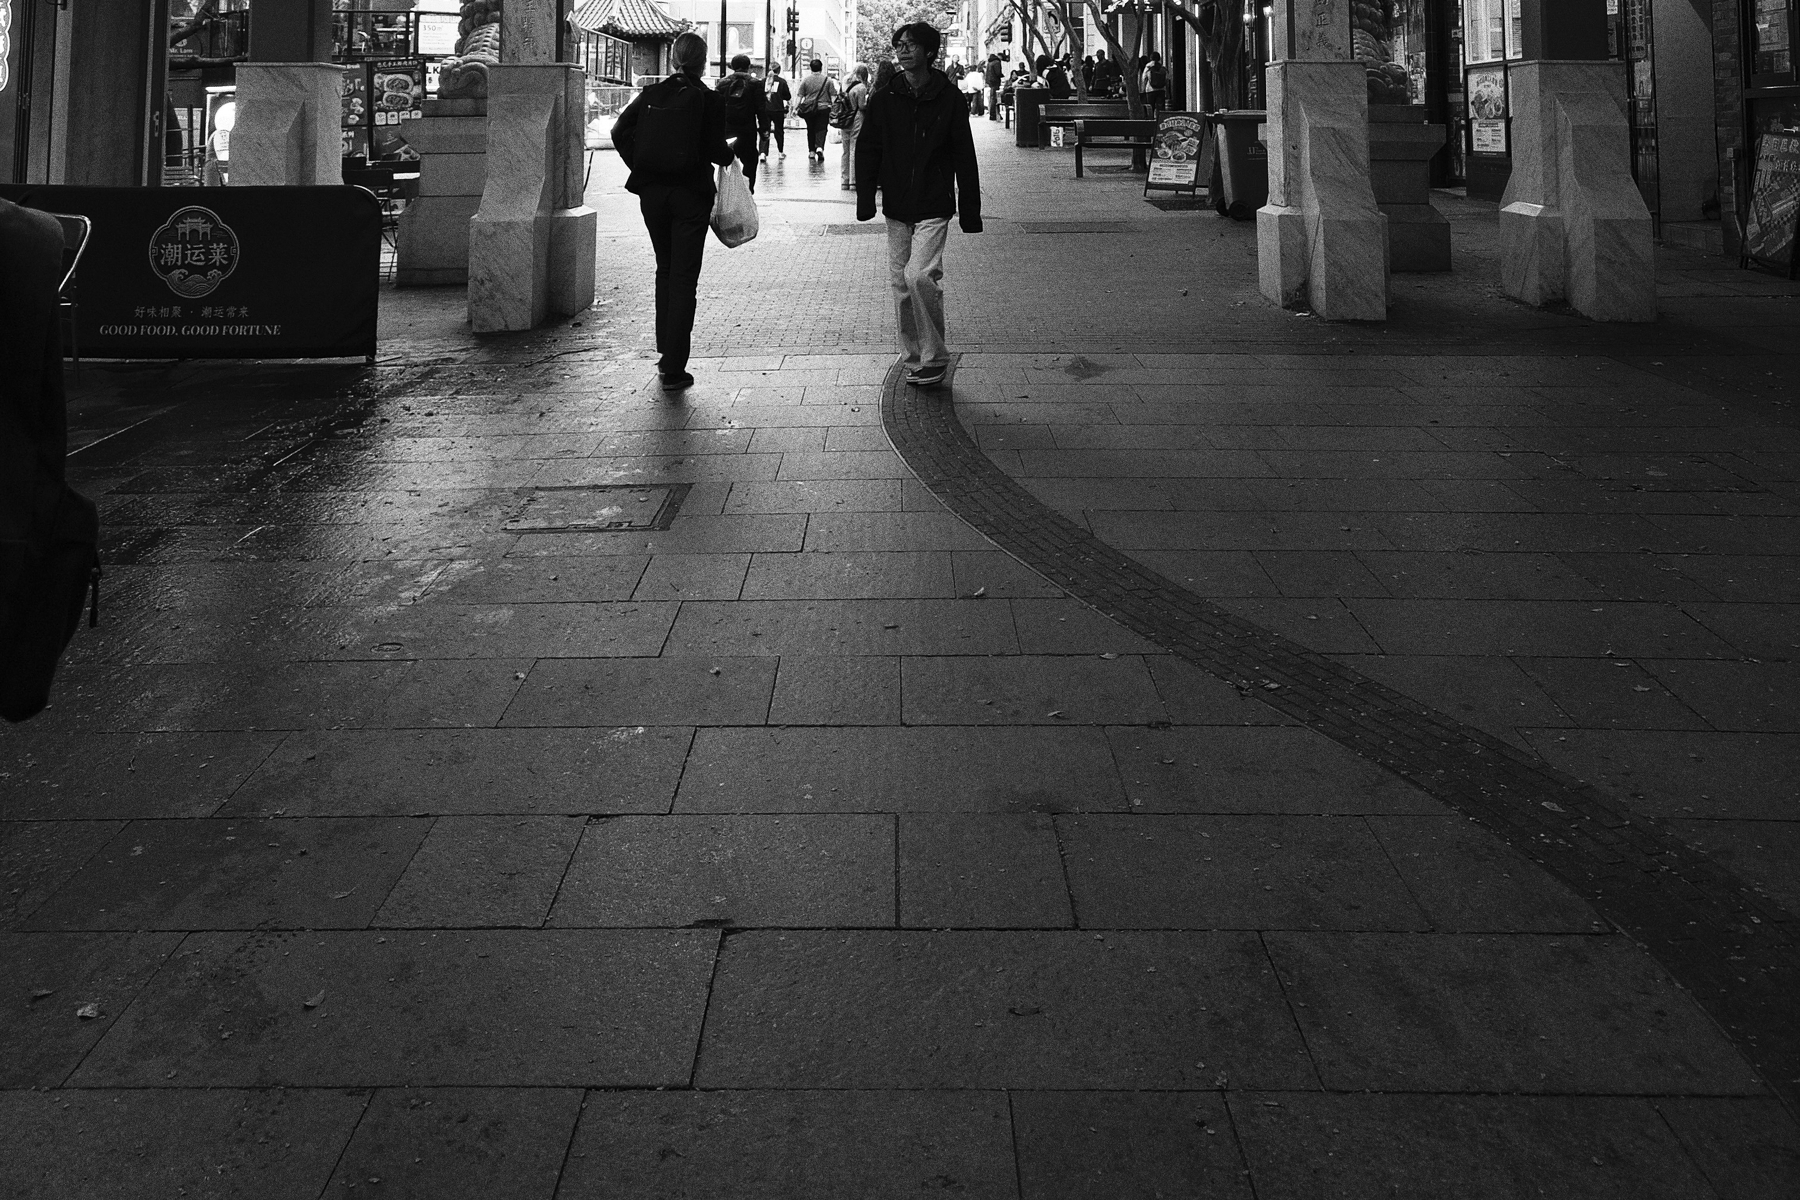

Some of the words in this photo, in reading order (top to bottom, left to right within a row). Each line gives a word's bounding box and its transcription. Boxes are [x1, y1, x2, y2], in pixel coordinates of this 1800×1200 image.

[159, 242, 230, 267] 潮运莱
[133, 305, 183, 319] 好味相聚
[200, 305, 250, 319] 潮运常来
[98, 324, 138, 337] GOOD
[139, 324, 179, 337] FOOD.
[180, 324, 220, 337] GOOD
[221, 324, 282, 337] FORTUNE
